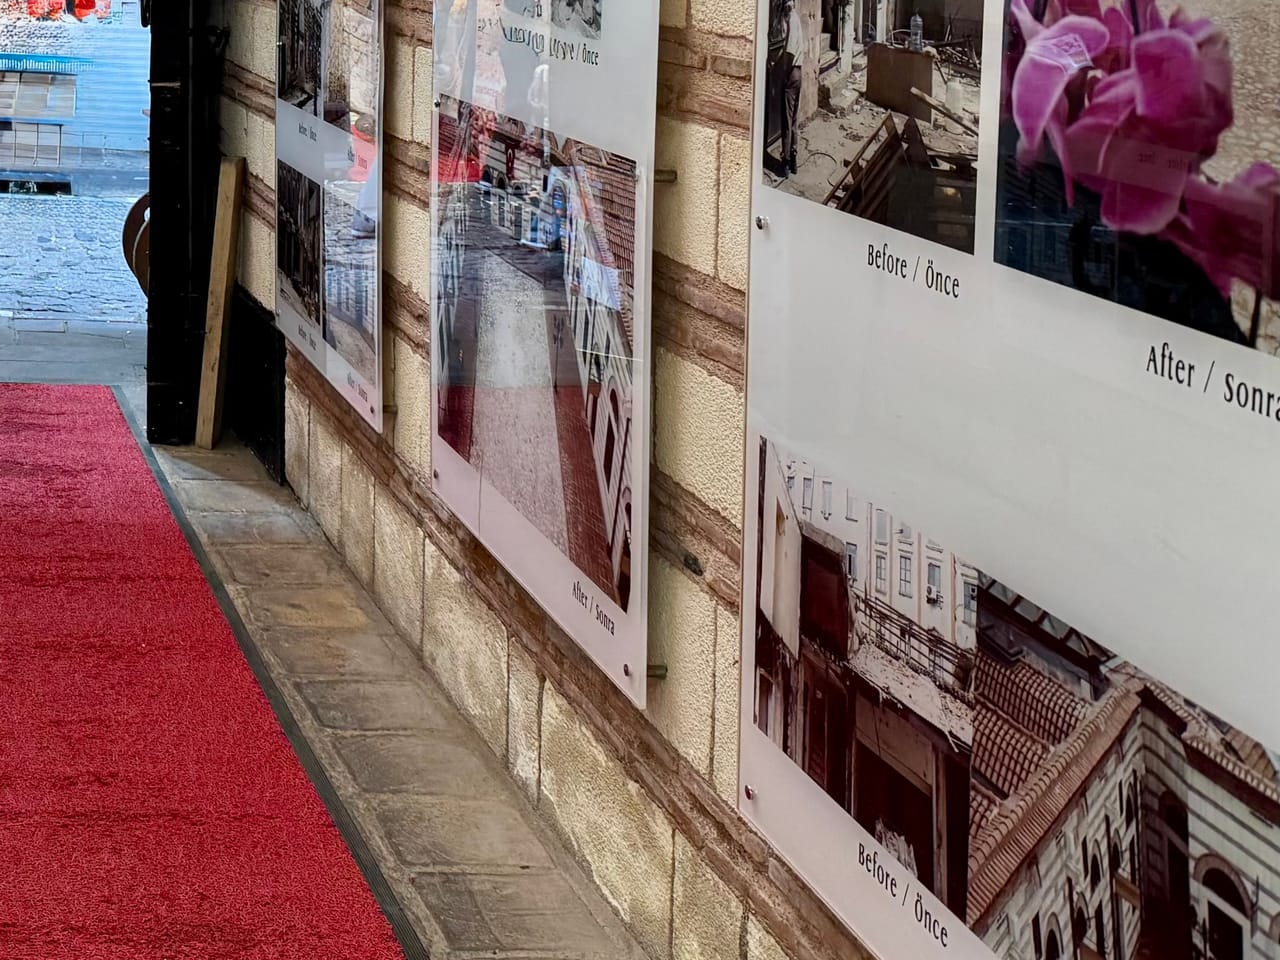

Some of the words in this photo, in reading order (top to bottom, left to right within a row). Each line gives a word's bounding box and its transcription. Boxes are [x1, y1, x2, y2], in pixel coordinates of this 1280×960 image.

[867, 243, 907, 279] Before
[925, 259, 960, 298] Önce
[1146, 342, 1195, 388] After
[572, 580, 588, 609] After
[595, 604, 615, 636] Sonra
[858, 842, 897, 898] Before
[914, 892, 948, 948] Önce
